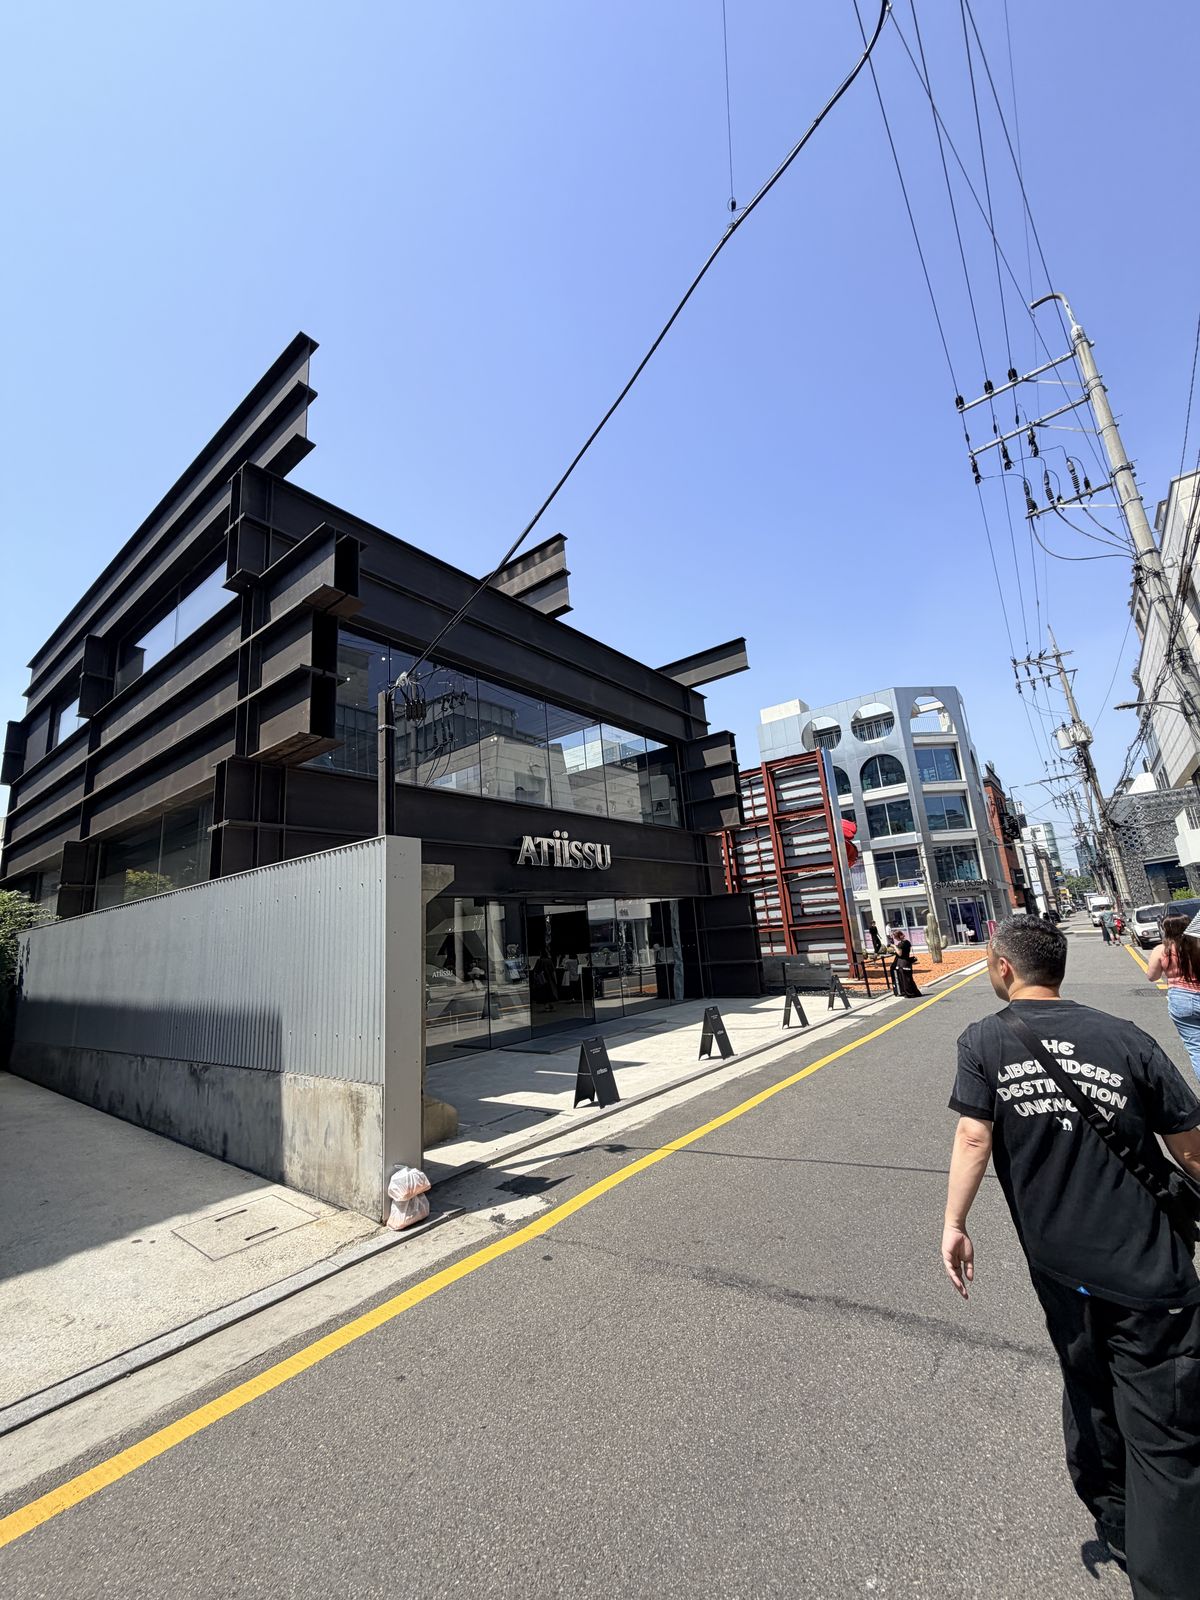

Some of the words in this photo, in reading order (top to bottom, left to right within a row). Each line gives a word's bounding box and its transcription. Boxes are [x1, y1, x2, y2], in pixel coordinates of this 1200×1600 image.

[1041, 1039, 1075, 1056] HE
[998, 1058, 1124, 1087] LIBEIDERS
[996, 1078, 1128, 1110] DESTINTION
[1013, 1097, 1115, 1122] UNKNON
